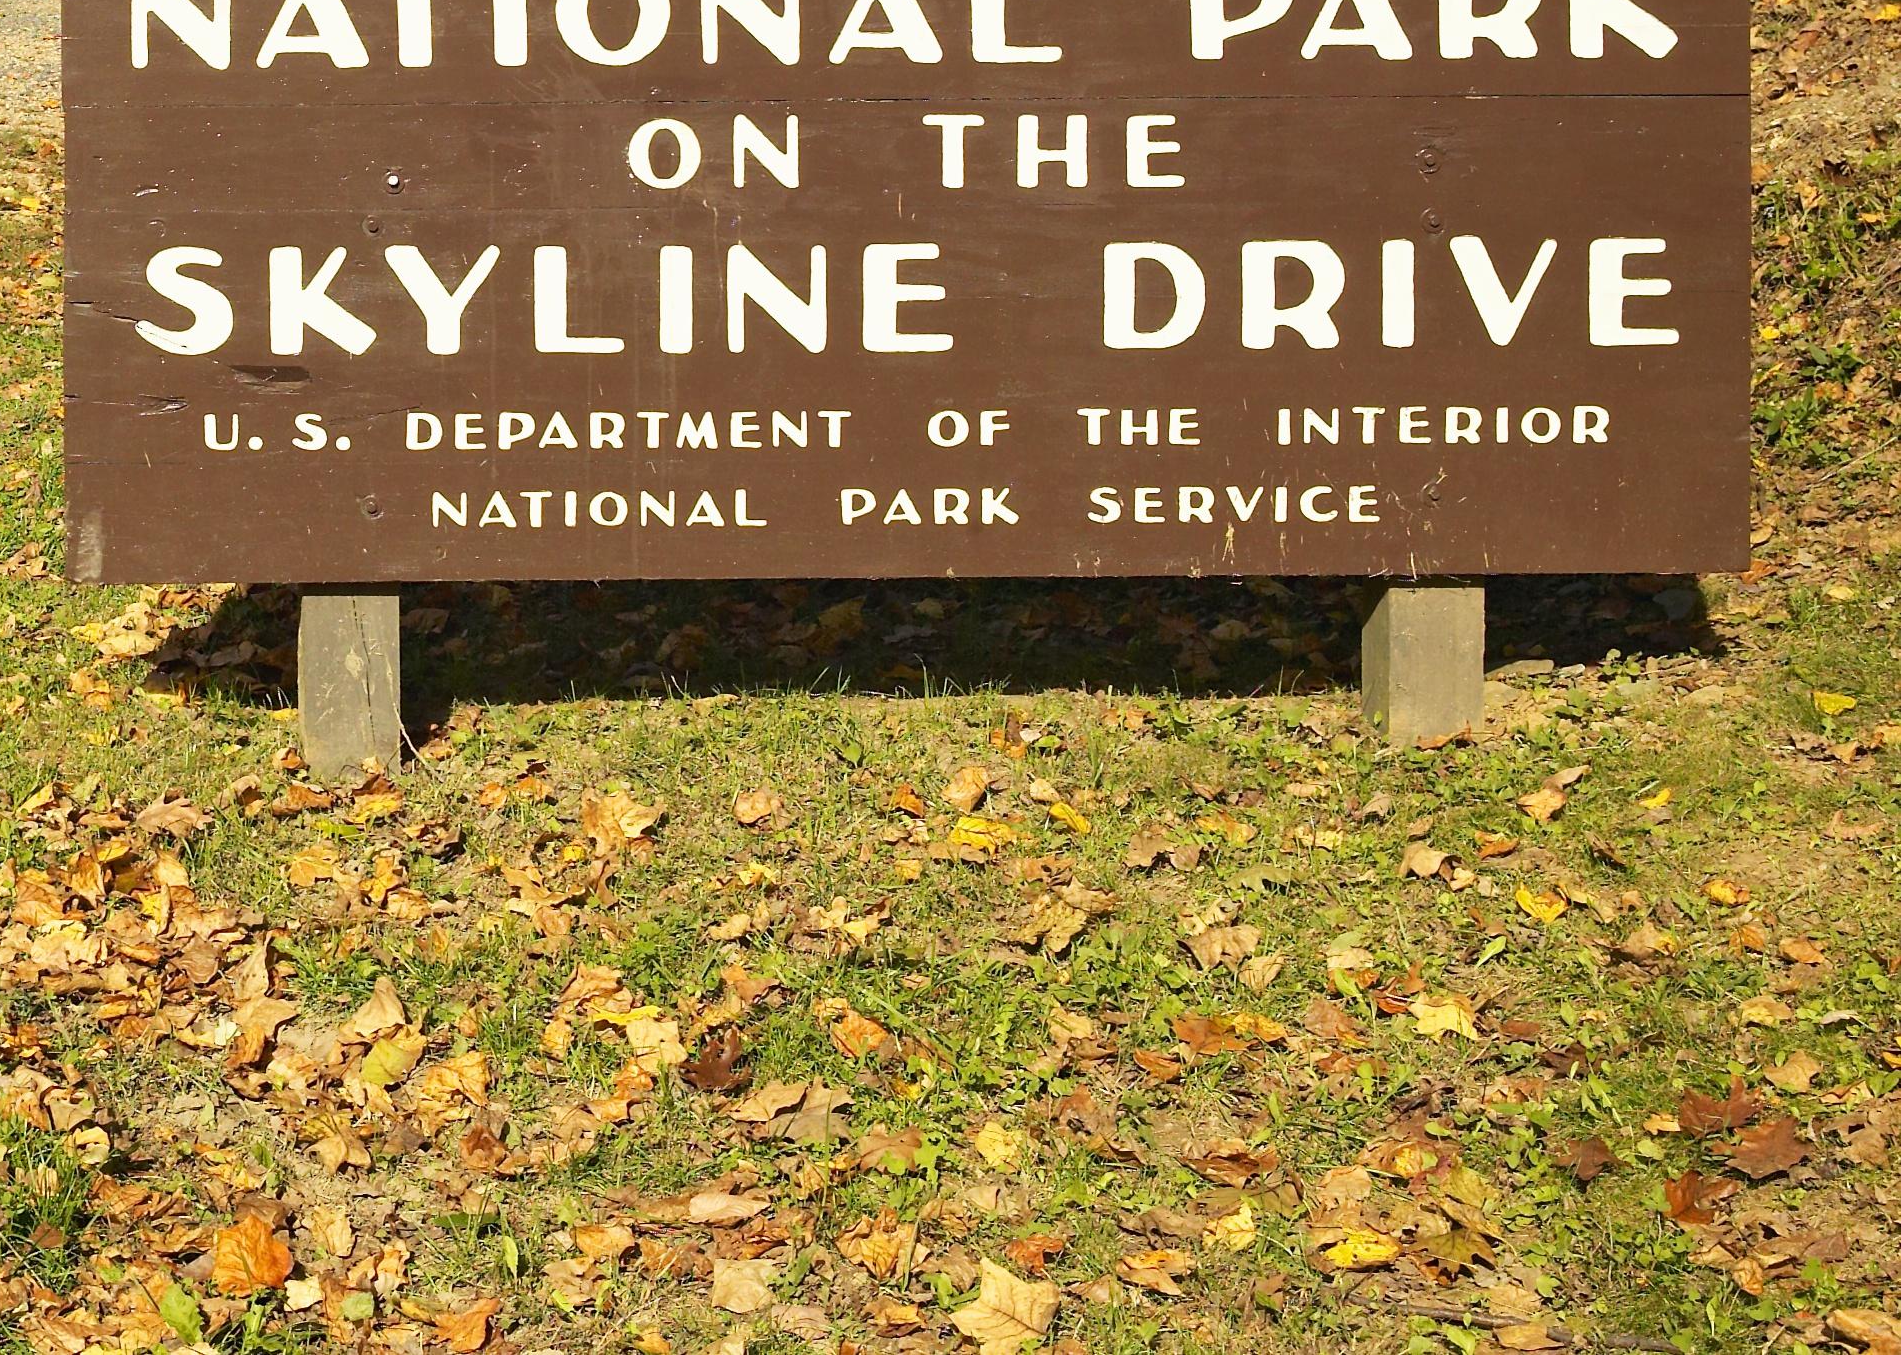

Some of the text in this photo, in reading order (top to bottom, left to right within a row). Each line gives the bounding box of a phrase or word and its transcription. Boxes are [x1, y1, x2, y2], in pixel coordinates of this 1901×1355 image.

[625, 114, 1186, 190] ON THE
[134, 234, 1680, 358] SKYLINE DRIVE
[405, 410, 852, 451] DEPARTMENT
[927, 410, 1010, 448] OF
[1076, 408, 1201, 446] THE
[1277, 405, 1610, 446] INTERIOR
[432, 485, 1381, 528] NATIONAL PARK SERVICE
